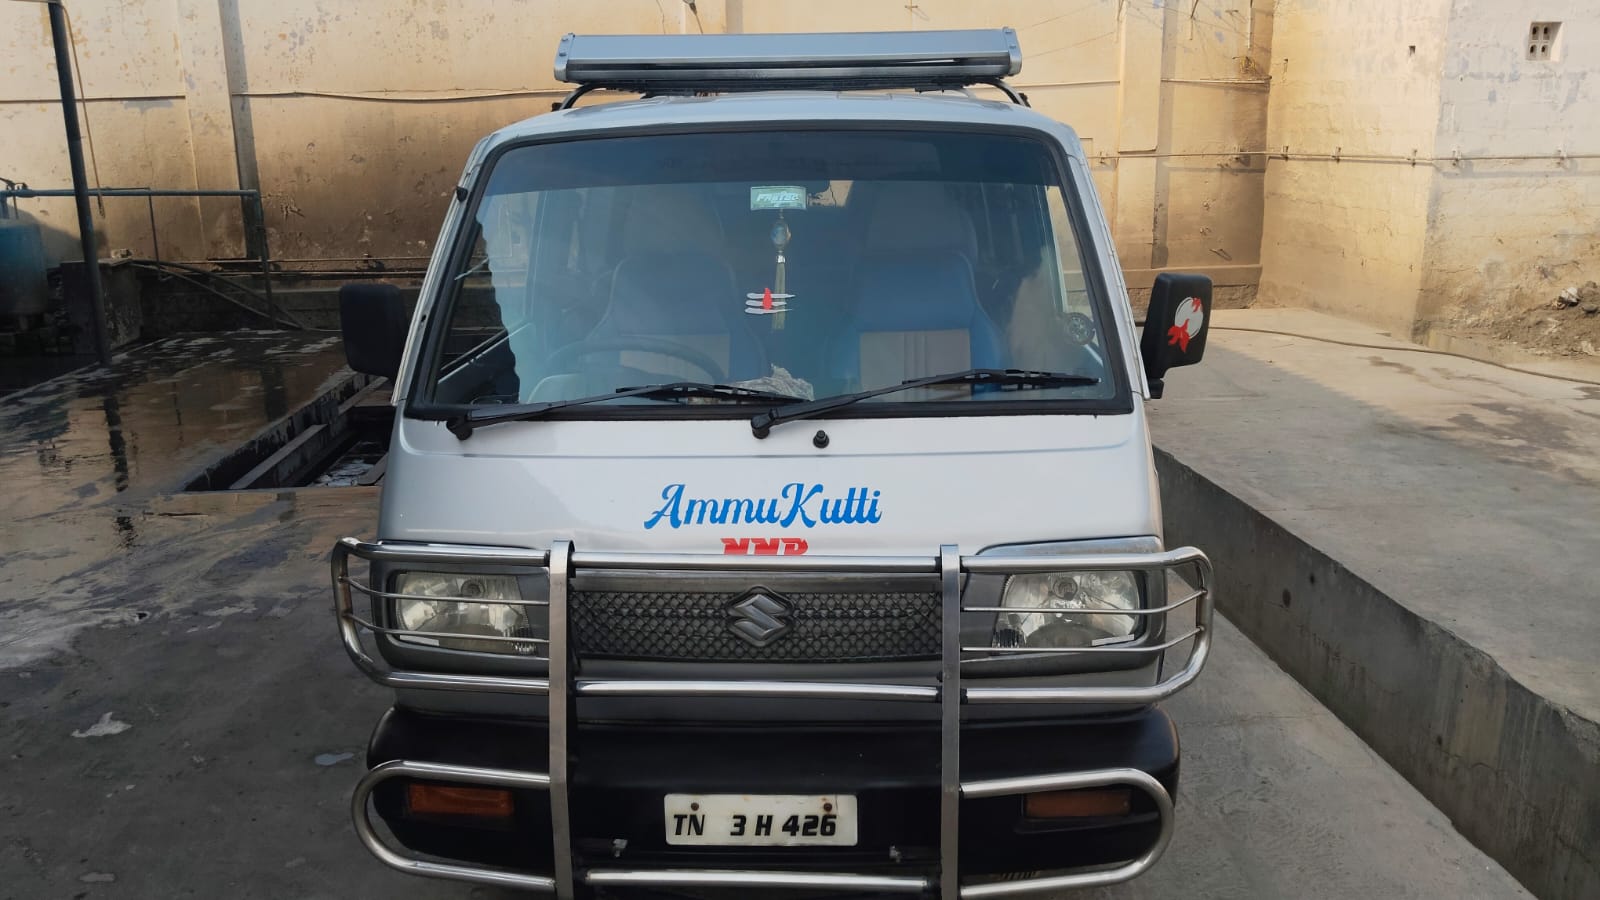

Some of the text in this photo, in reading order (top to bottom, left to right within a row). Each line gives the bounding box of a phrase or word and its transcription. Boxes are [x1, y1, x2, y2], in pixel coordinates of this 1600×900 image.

[644, 483, 882, 529] AmmuKutti
[673, 814, 837, 836] TN 3 H 426
